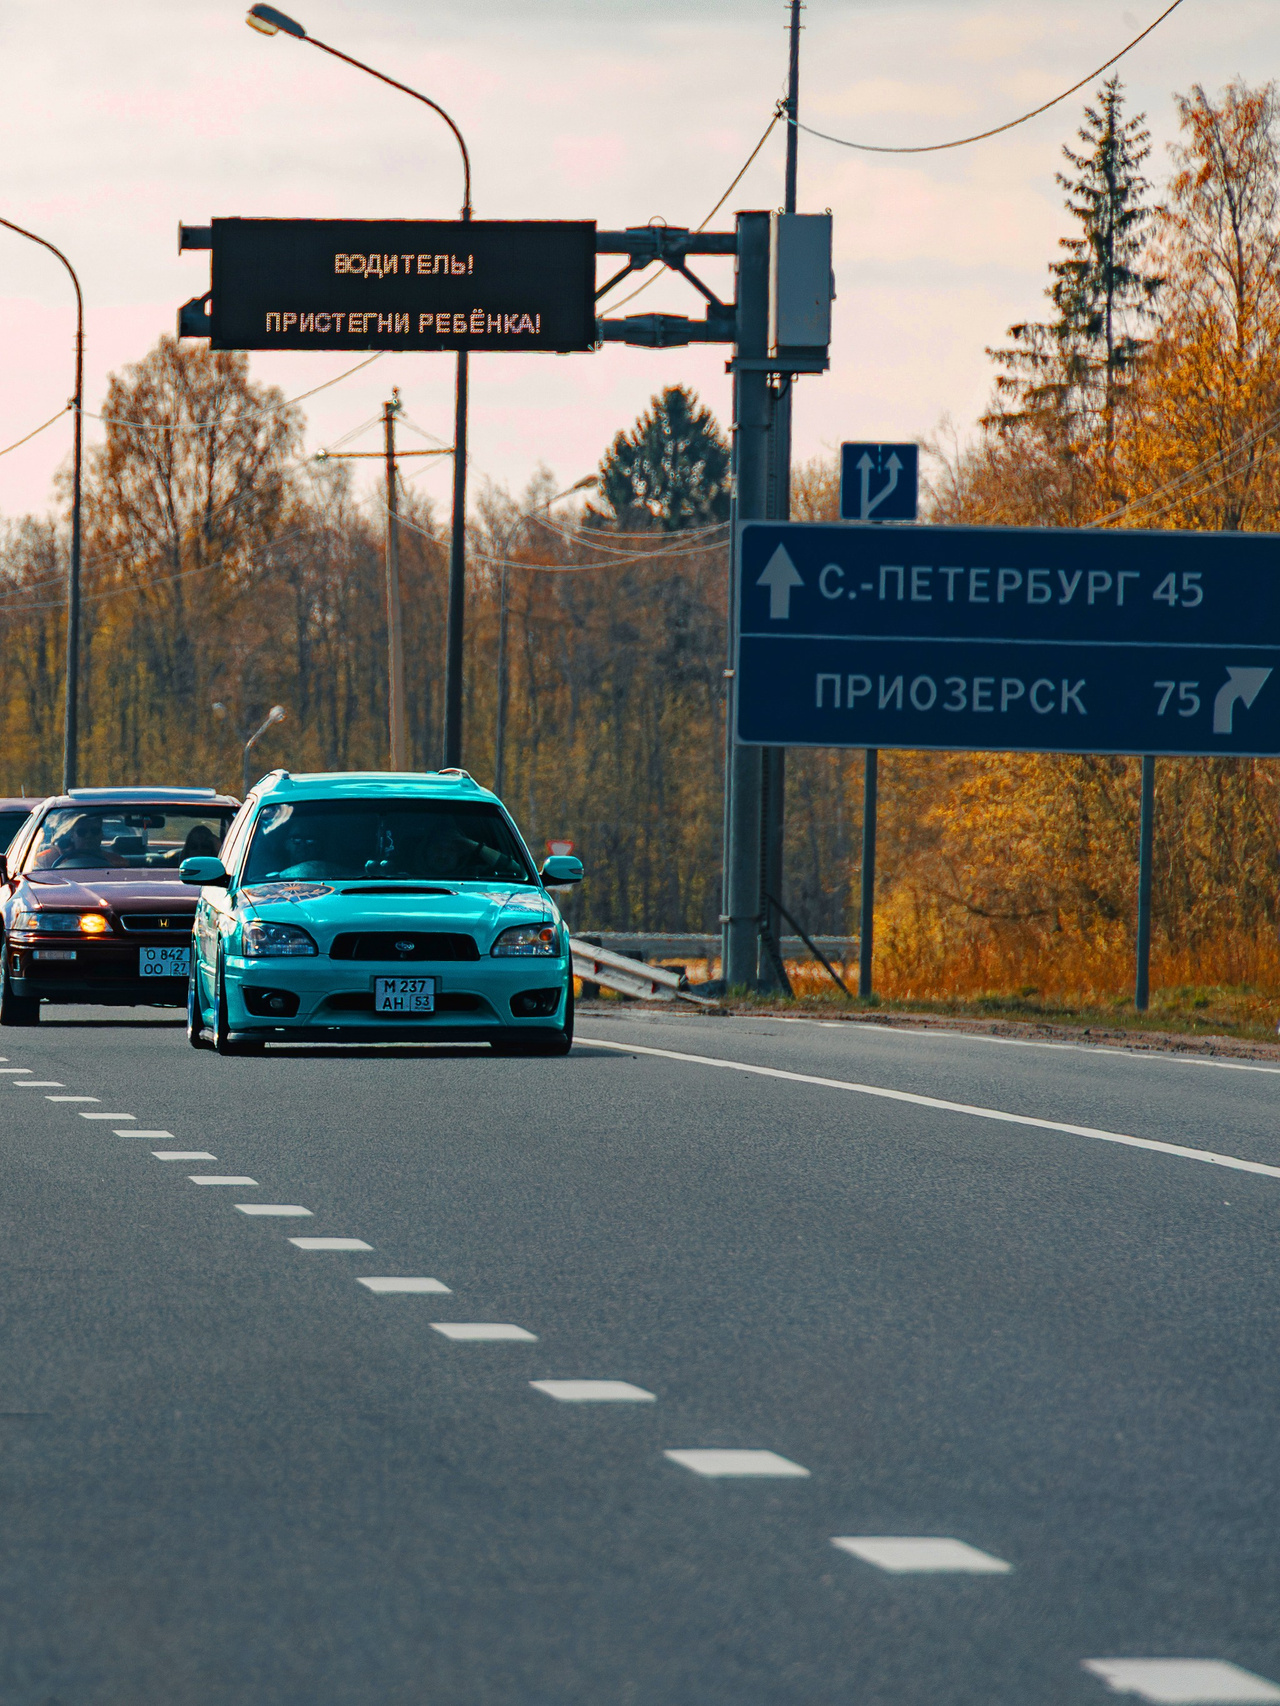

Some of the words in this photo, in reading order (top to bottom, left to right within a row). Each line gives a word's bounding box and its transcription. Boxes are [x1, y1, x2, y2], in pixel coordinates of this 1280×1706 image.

[334, 253, 474, 279] ВОДИТЕЛЬ!
[265, 311, 410, 334] ПРИСТЕГНИ
[418, 308, 541, 334] РЕБЁНКА!
[818, 564, 1141, 607] С.-ПЕТЕРБУРГ
[1152, 571, 1204, 608] 45
[815, 673, 1088, 715] ПРИОЗЕРСК
[1154, 681, 1201, 717] 75
[146, 949, 156, 961] О
[160, 949, 183, 961] 842
[173, 963, 186, 972] 27
[384, 980, 396, 993] М
[400, 980, 426, 993] 237
[382, 997, 404, 1010] АН
[415, 996, 429, 1006] 53
